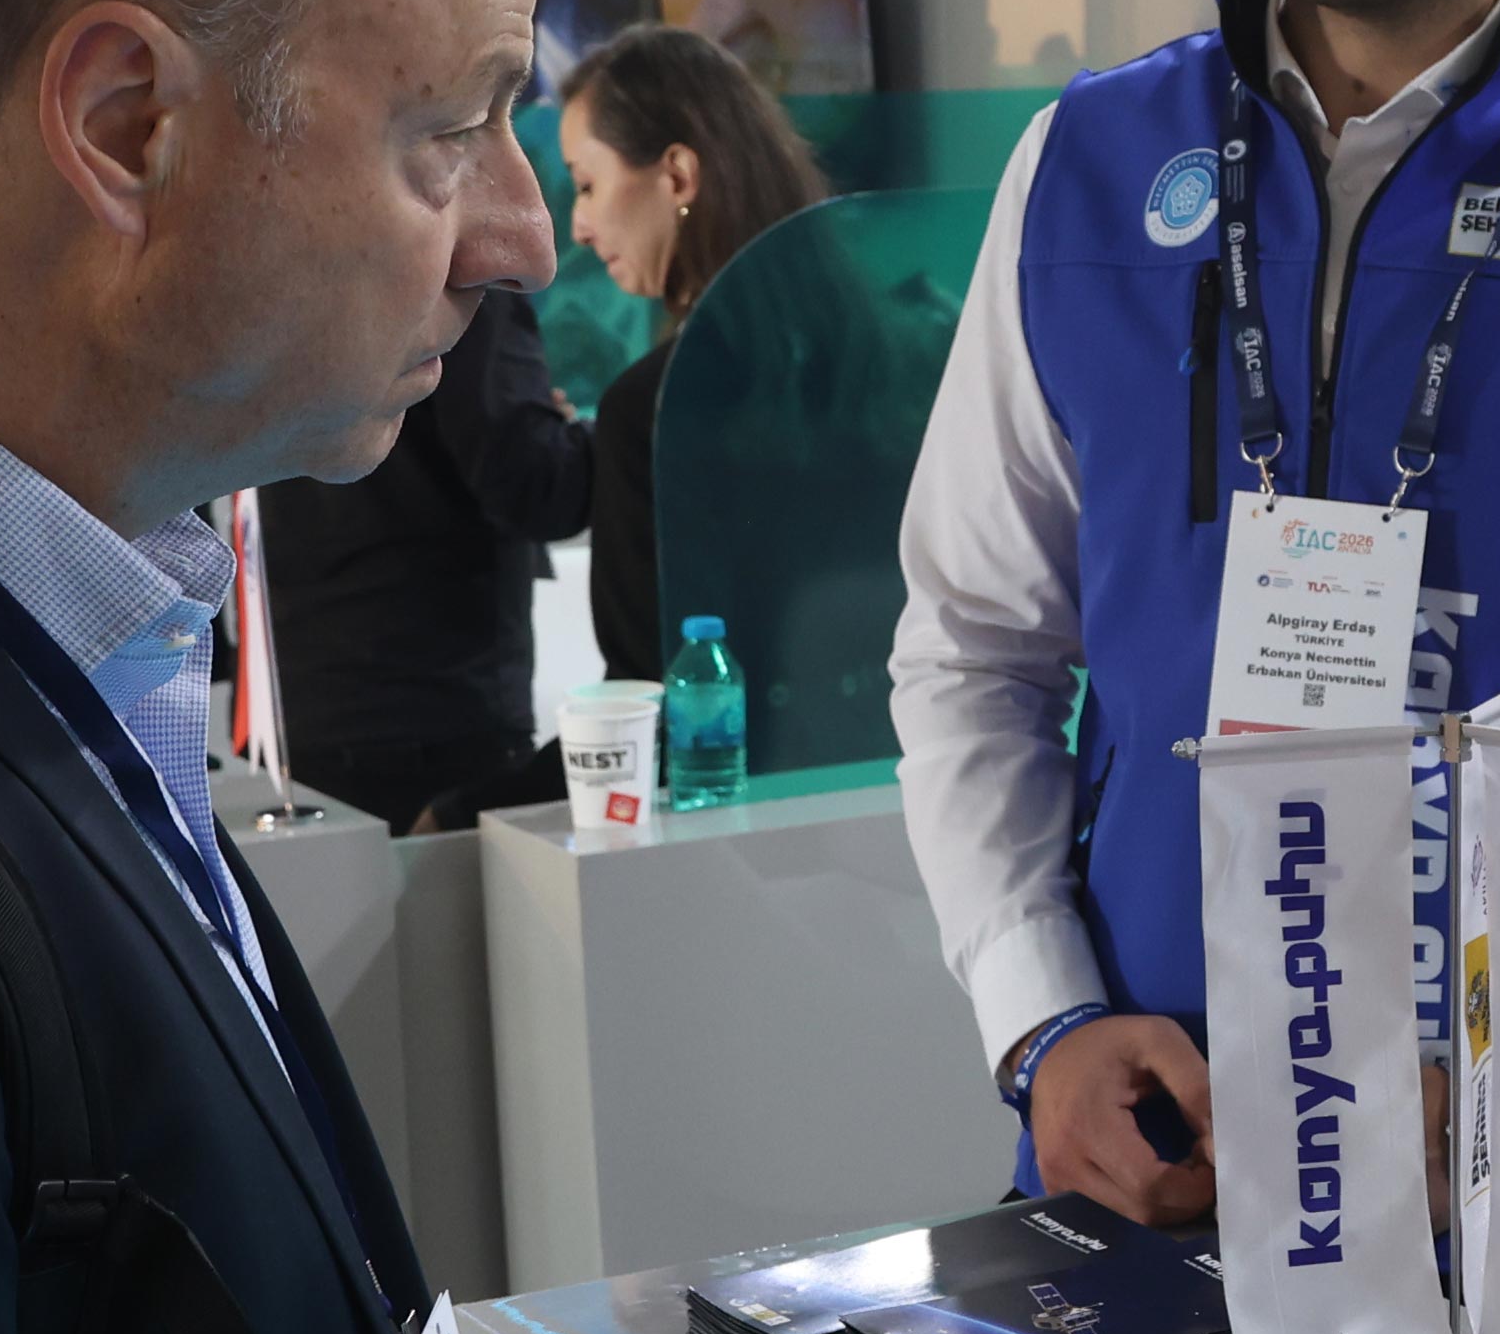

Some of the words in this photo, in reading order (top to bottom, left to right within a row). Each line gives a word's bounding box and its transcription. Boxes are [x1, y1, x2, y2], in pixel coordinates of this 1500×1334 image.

[1338, 532, 1374, 548] 2026
[1266, 613, 1328, 632] Alpgiray
[1333, 619, 1376, 636] Erdaş
[1295, 634, 1345, 648] TÜRKİYE
[1260, 647, 1302, 663] Konya
[1306, 650, 1376, 668] Necmettin
[1247, 664, 1302, 680] Erbakan
[1306, 668, 1386, 688] Üniversitesi
